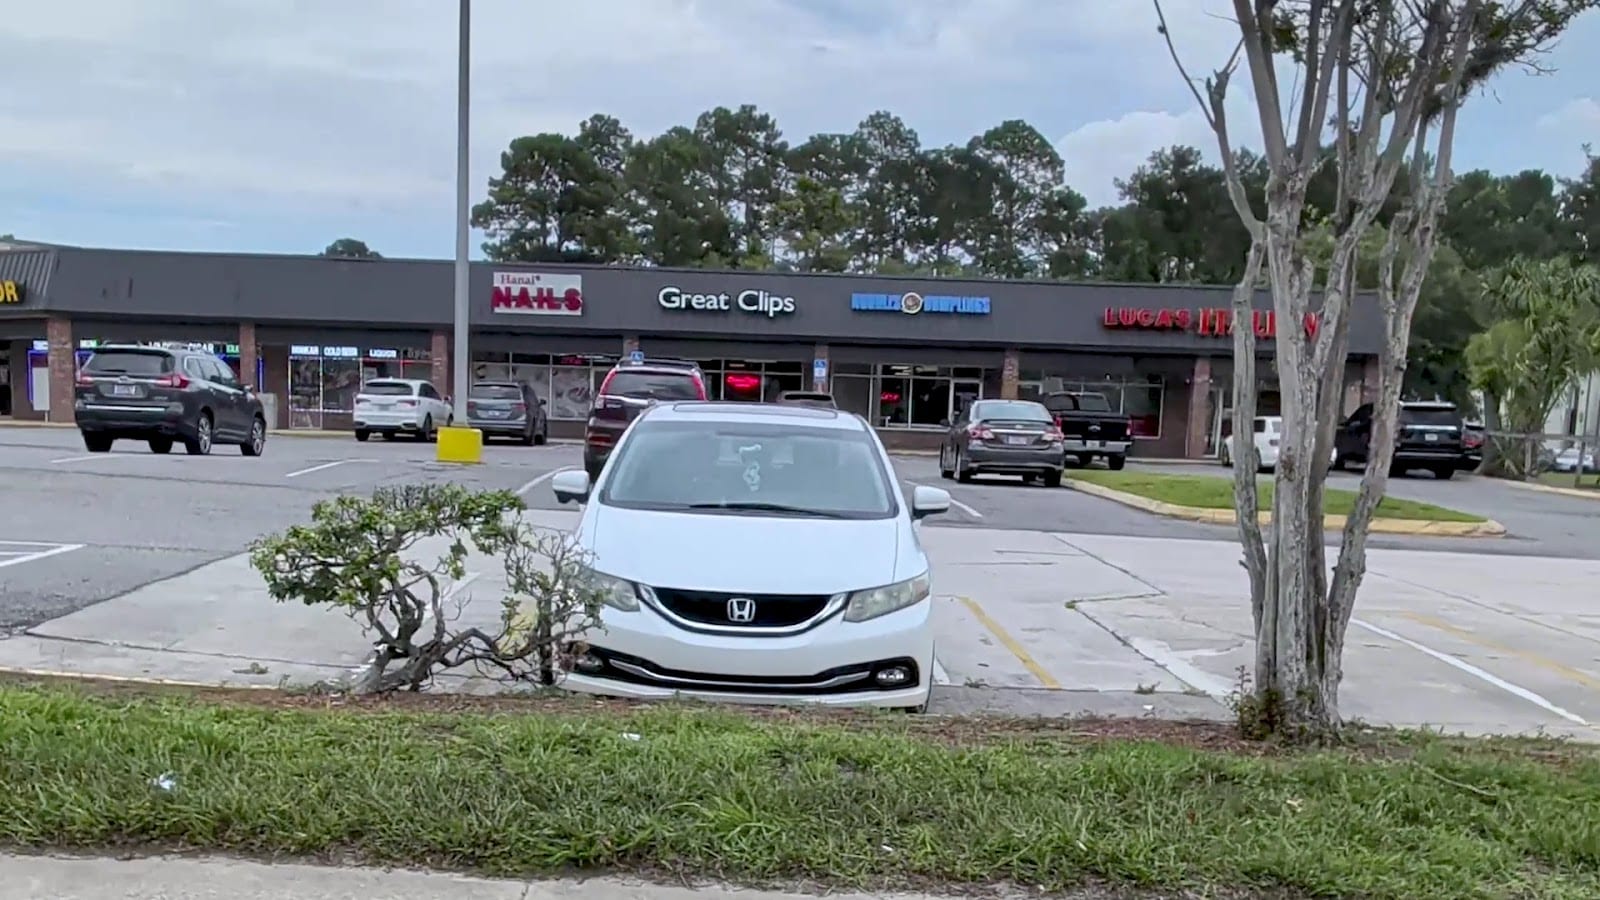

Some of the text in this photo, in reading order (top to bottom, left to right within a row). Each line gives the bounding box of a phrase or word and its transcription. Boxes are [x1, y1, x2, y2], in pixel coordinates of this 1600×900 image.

[491, 286, 583, 311] NAILS
[658, 286, 796, 317] Great Clips
[1198, 306, 1323, 340] ITLIN
